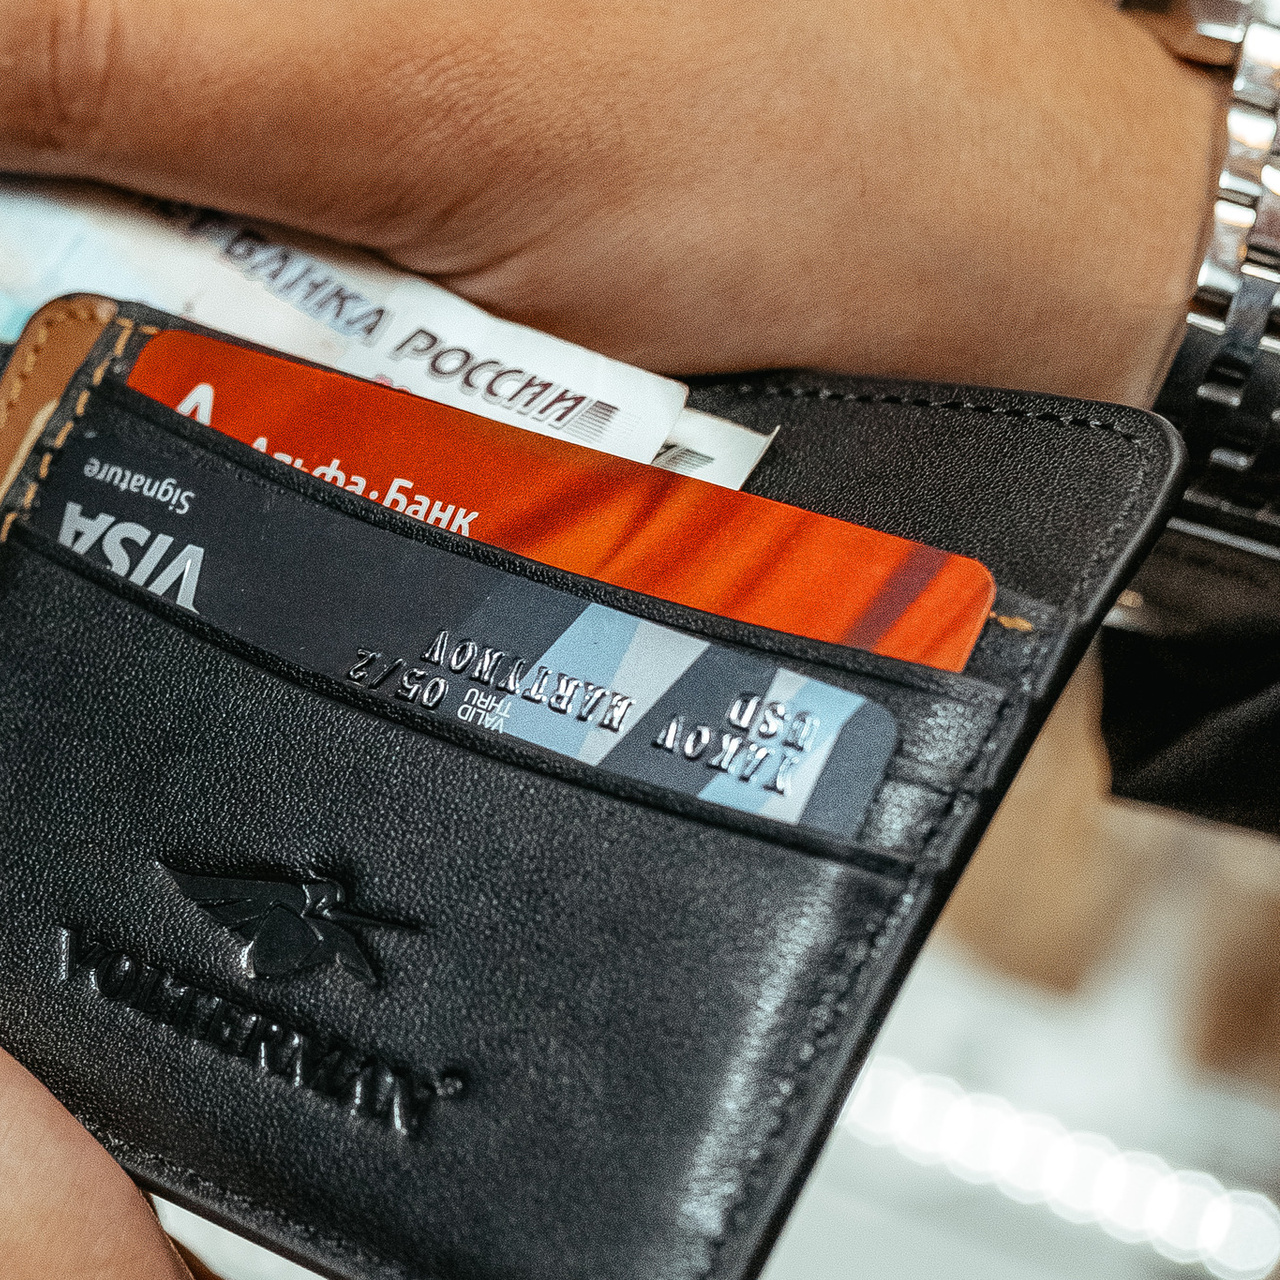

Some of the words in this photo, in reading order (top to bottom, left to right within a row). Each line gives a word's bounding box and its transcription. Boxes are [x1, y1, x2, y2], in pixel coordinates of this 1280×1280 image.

[222, 231, 387, 344] БАНКА
[395, 329, 590, 429] РОССИИ
[83, 457, 195, 515] Signature
[57, 501, 205, 615] VISA
[422, 629, 636, 732] MARTYNOV
[463, 687, 511, 717] THRU
[457, 703, 505, 734] VALID
[727, 690, 818, 751] USD
